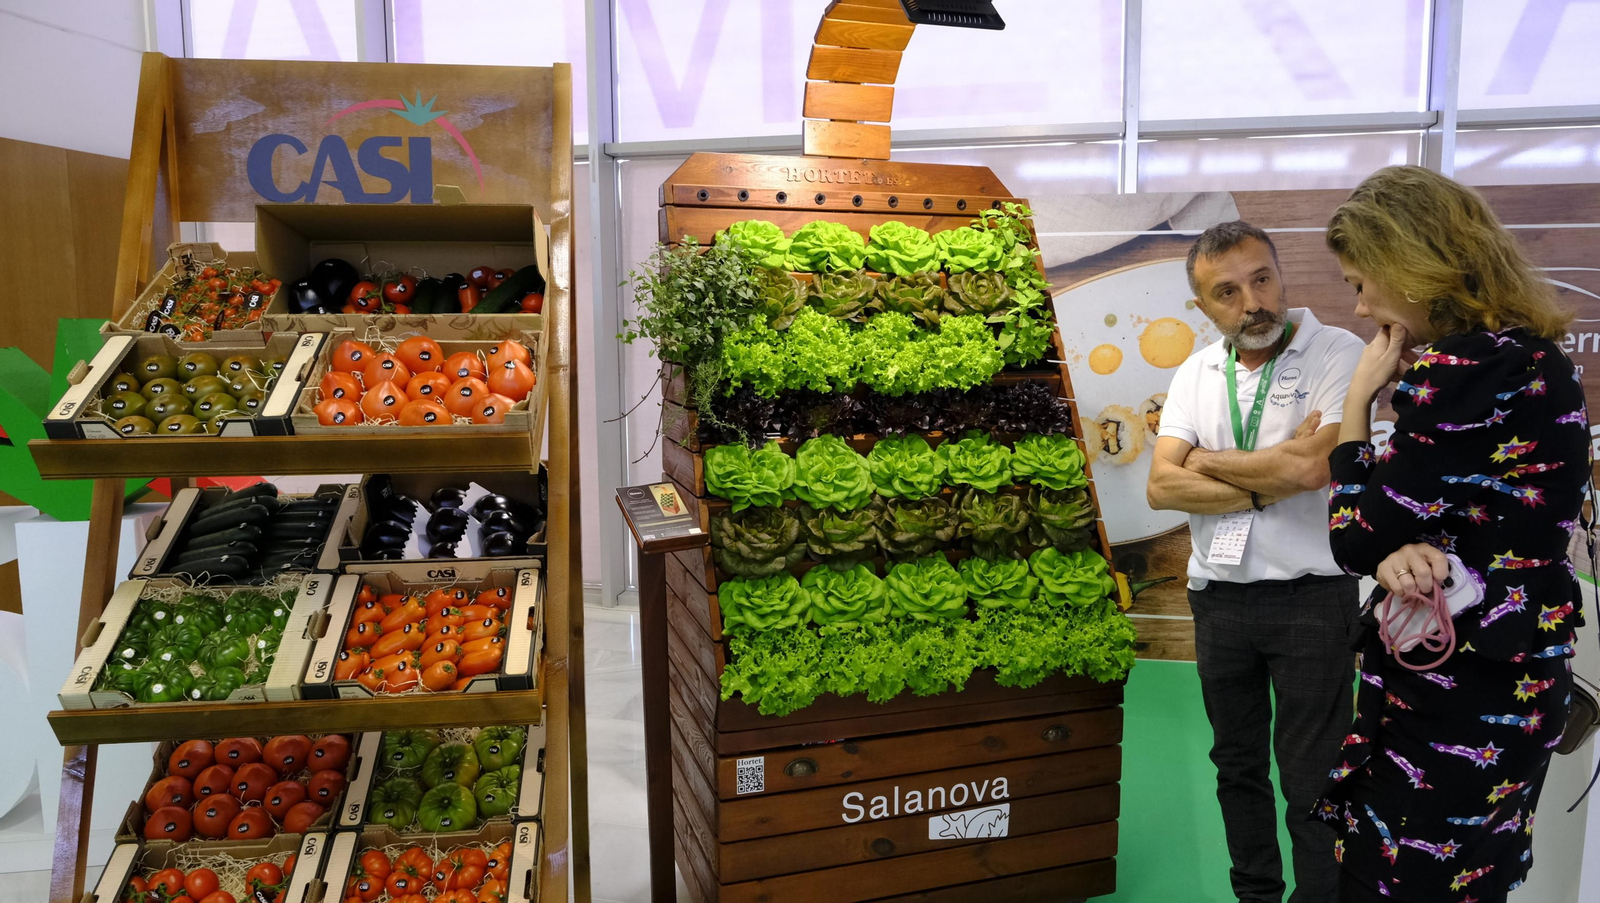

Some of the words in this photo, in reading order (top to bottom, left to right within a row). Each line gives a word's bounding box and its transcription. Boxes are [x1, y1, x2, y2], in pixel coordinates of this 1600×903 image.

[247, 133, 434, 204] CASI
[427, 569, 456, 579] CASI
[306, 580, 319, 596] CASI
[315, 661, 328, 679] CASI
[841, 776, 1010, 823] Salanova
[349, 803, 361, 821] CASI
[519, 826, 529, 844] CASI
[305, 837, 317, 855] CASI
